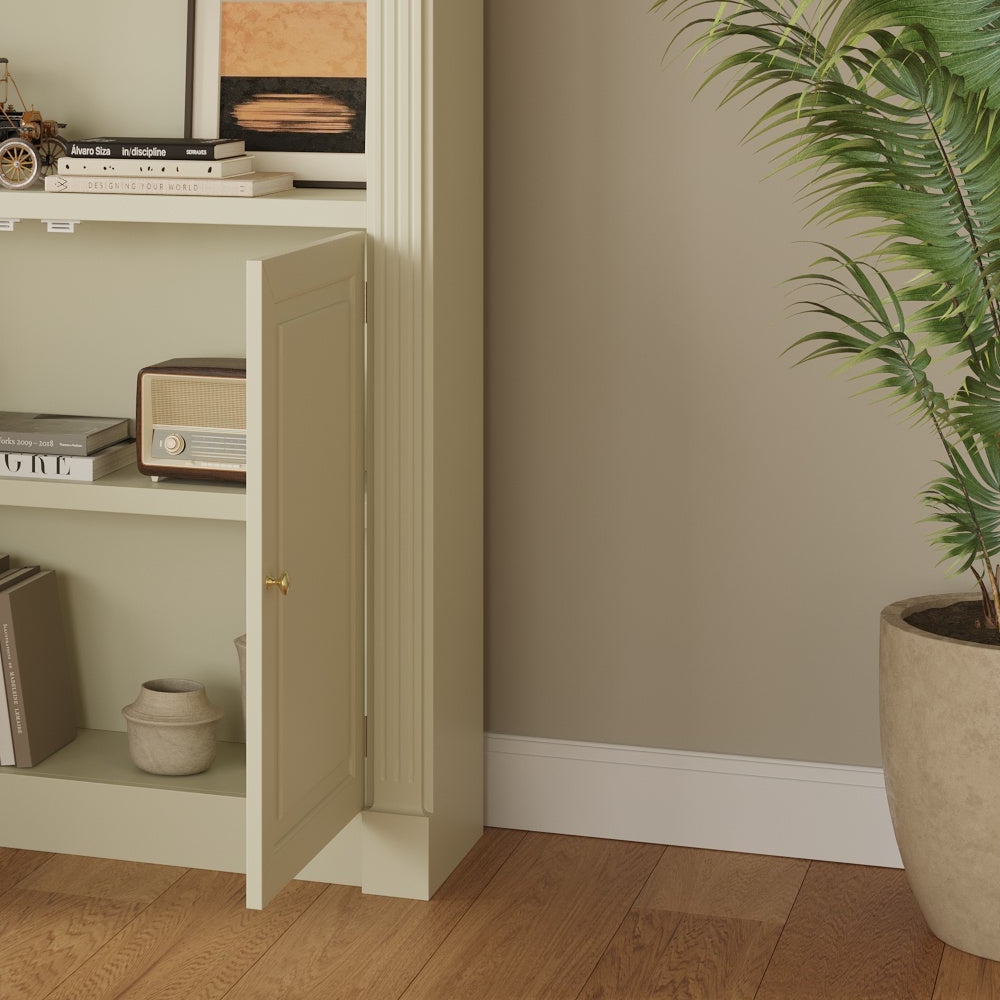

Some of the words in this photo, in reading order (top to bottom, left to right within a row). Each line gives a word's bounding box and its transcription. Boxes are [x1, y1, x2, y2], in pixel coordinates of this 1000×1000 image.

[71, 145, 94, 156] Álvaro
[95, 147, 111, 156] Siza
[88, 182, 137, 190] DESIGNING
[16, 439, 33, 448] 2009
